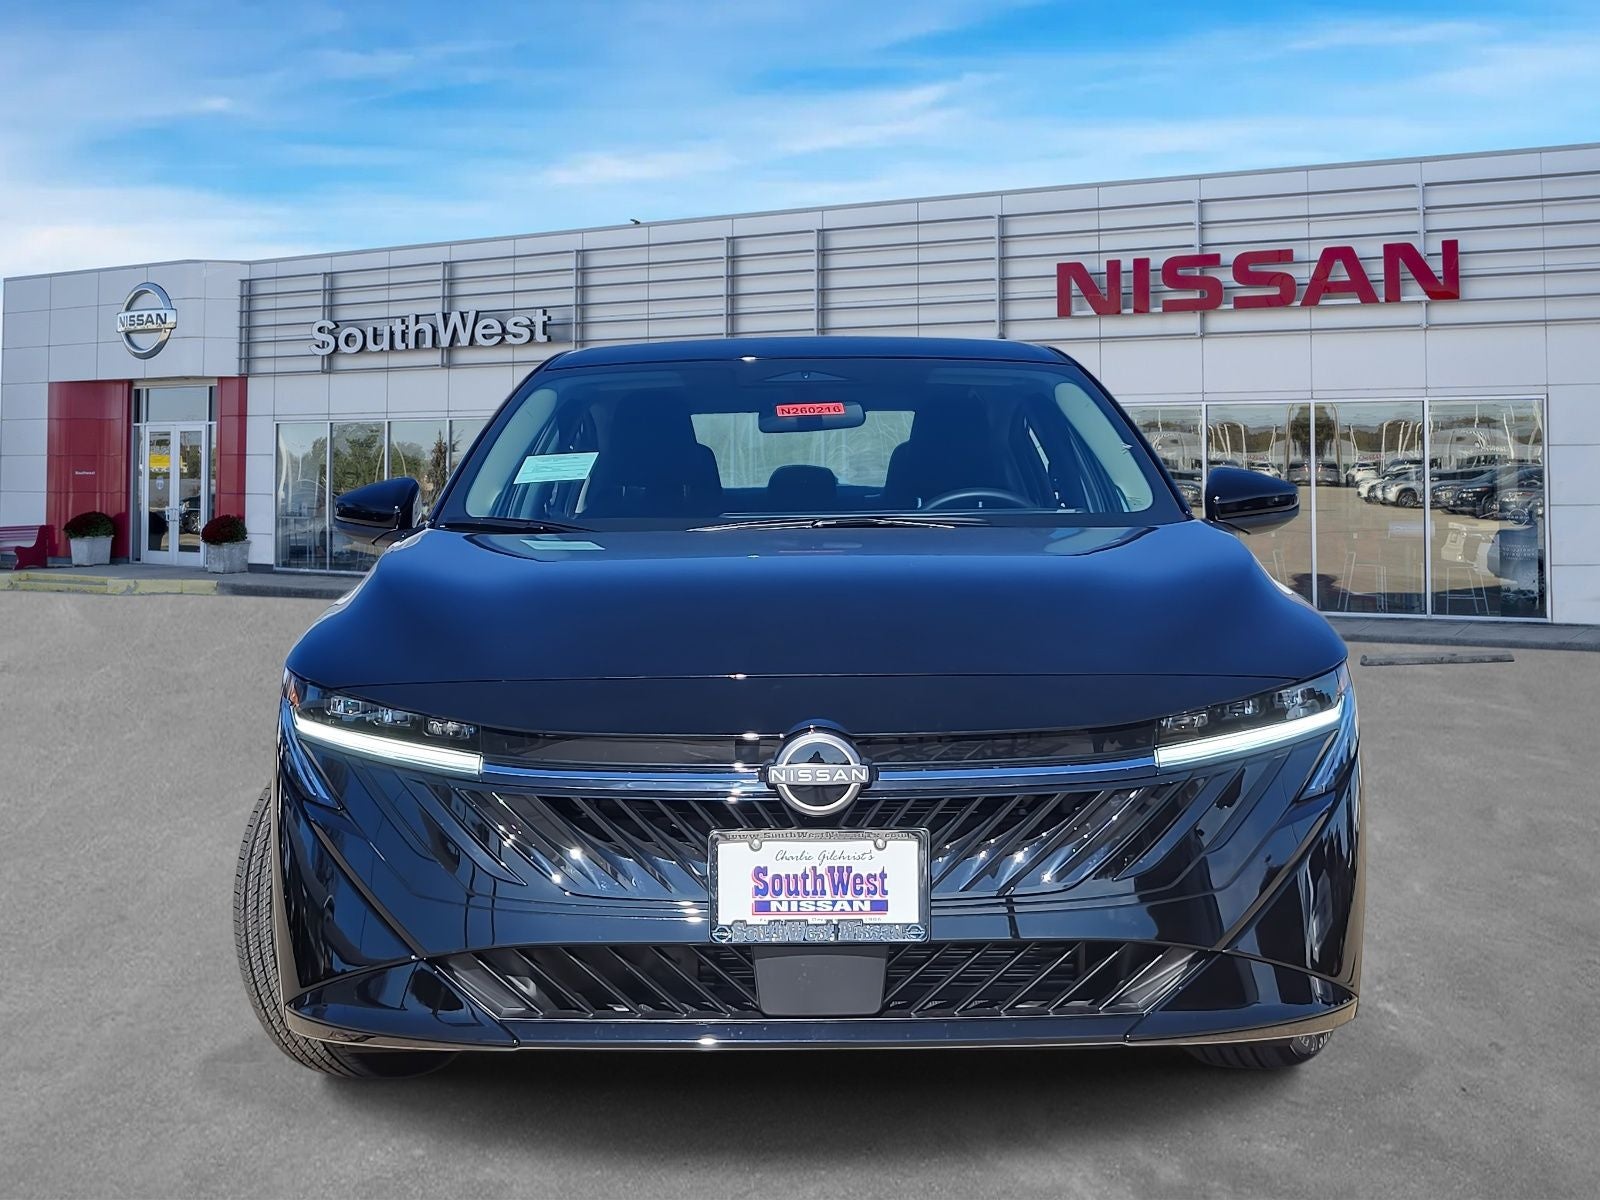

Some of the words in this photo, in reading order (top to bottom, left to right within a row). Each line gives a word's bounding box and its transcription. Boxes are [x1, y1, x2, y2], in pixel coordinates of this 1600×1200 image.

[1056, 239, 1461, 318] NISSAN
[119, 312, 168, 328] NISSAN
[309, 308, 552, 356] SouthWest
[769, 768, 868, 783] NISSAN
[775, 849, 814, 861] Charlie
[752, 865, 889, 899] SouthWest
[769, 900, 872, 912] NISSAN
